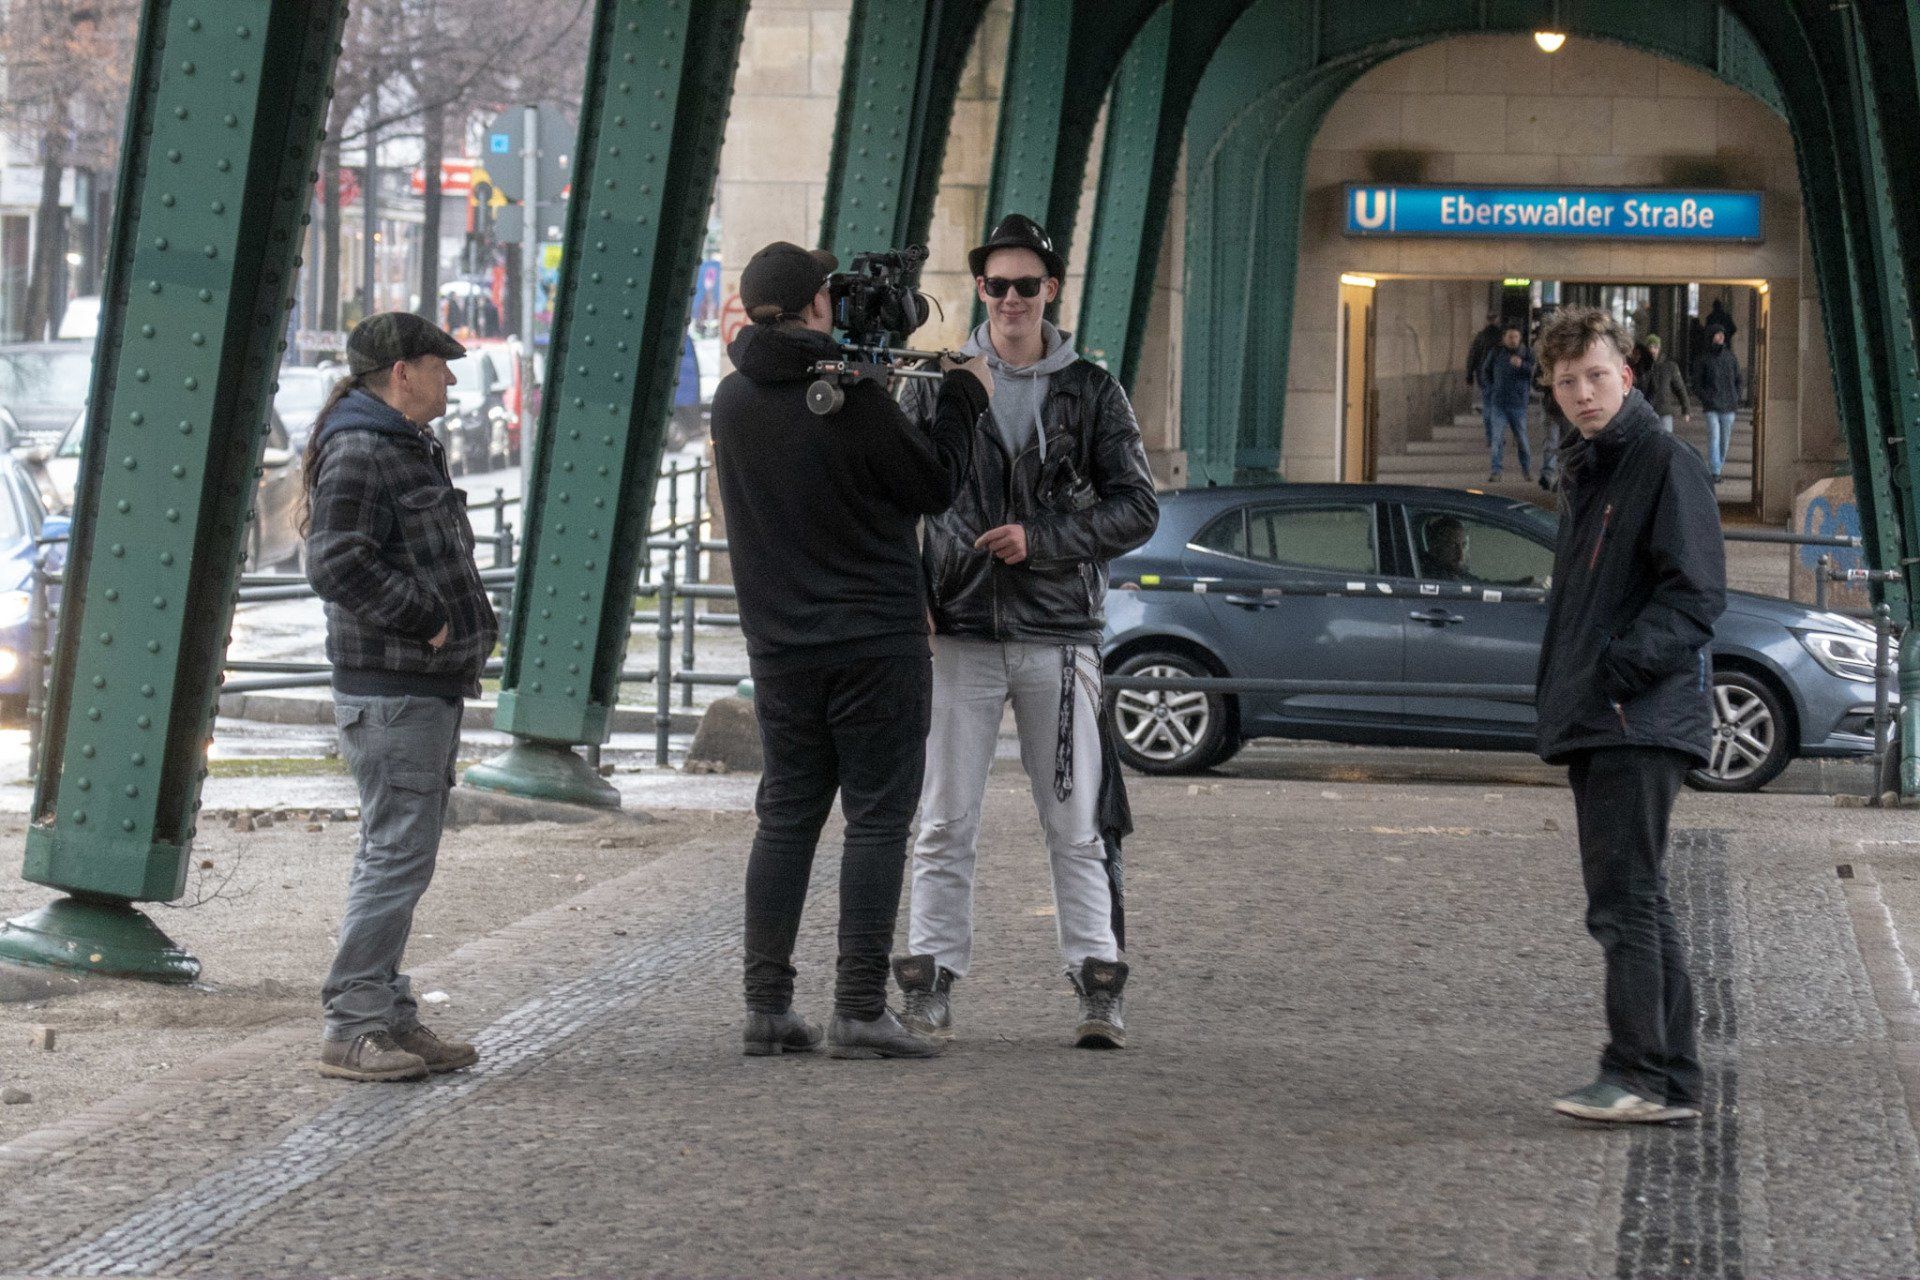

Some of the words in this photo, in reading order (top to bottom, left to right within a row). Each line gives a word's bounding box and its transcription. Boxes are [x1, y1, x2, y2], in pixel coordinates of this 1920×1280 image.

[1355, 190, 1386, 228] U
[1440, 195, 1615, 227] Eberswalder
[1623, 198, 1715, 228] Straße
